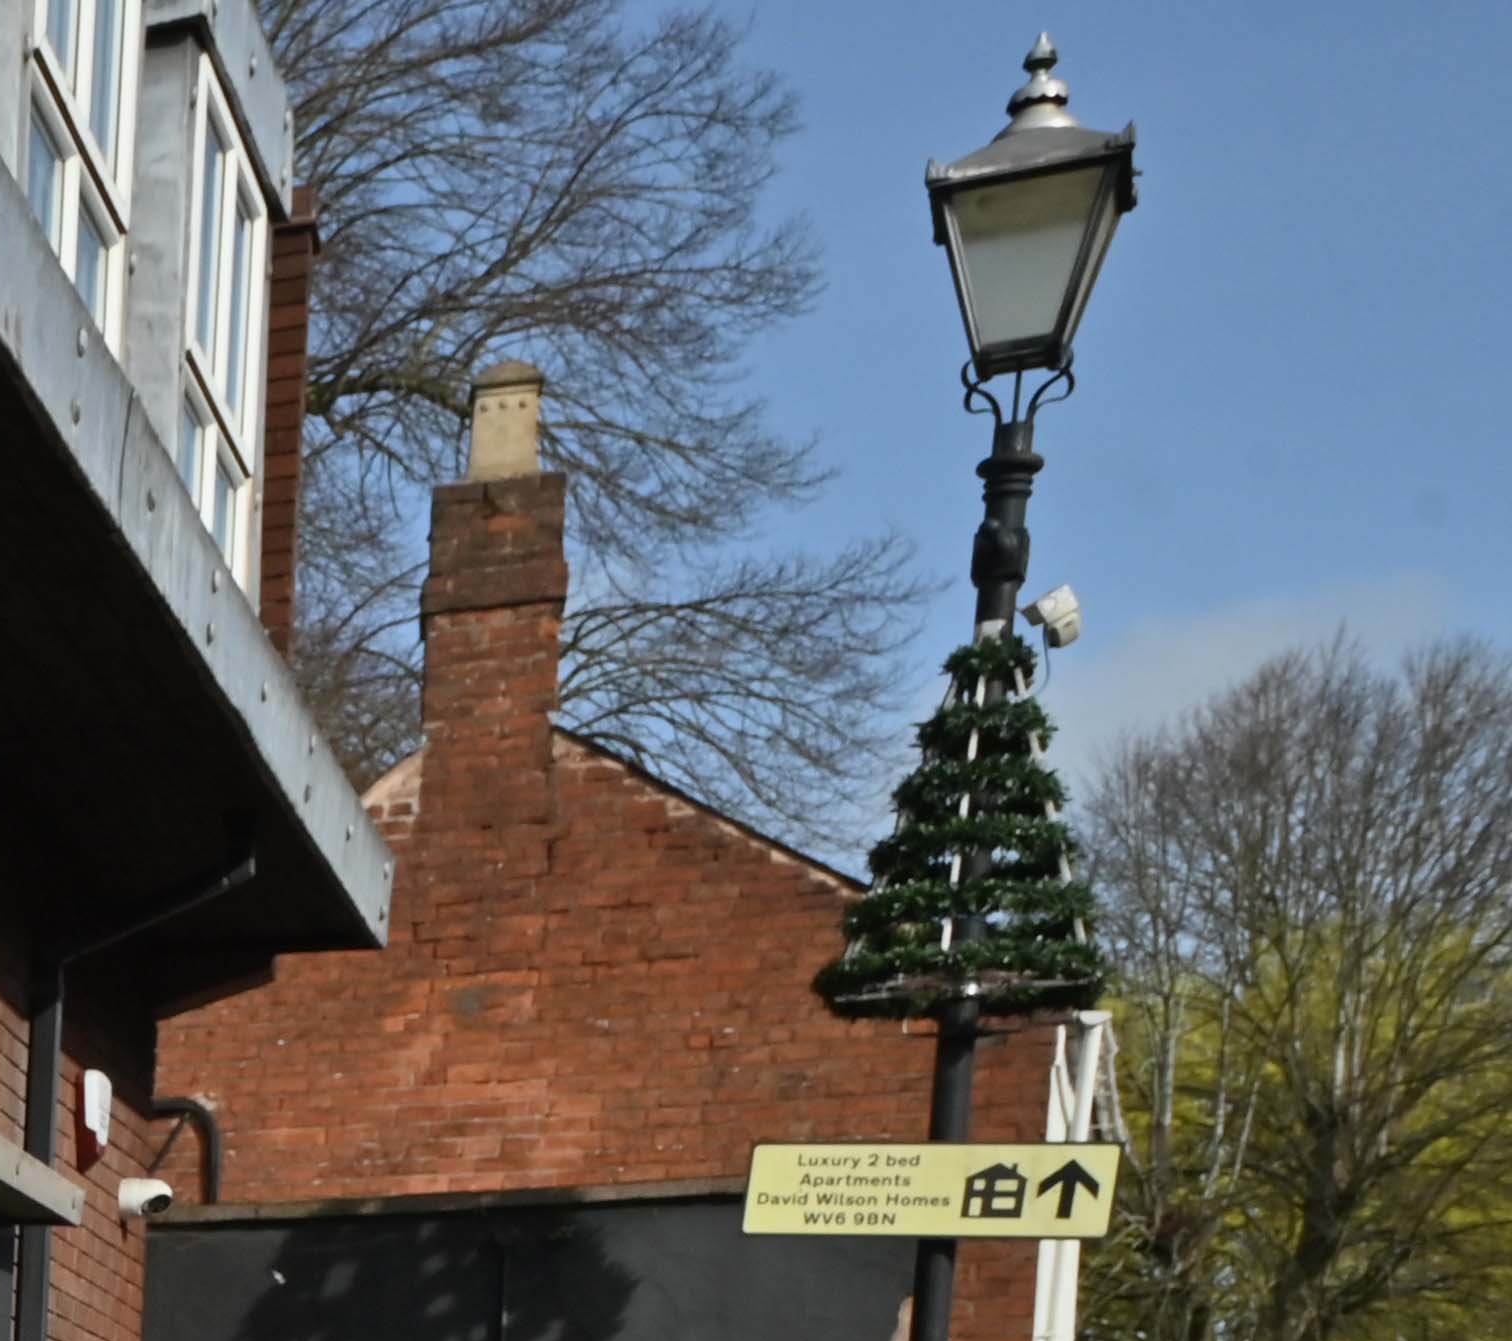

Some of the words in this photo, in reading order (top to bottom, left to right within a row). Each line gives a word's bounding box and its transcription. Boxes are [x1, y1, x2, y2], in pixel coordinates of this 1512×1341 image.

[797, 1153, 861, 1169] Luxury
[868, 1153, 880, 1167] 2
[885, 1153, 921, 1167] bed
[799, 1172, 912, 1188] Apartments
[756, 1191, 810, 1207] David
[816, 1192, 879, 1207] Wilson
[885, 1193, 951, 1208] Homes
[803, 1212, 847, 1226] WV6
[854, 1212, 897, 1226] 9BN
